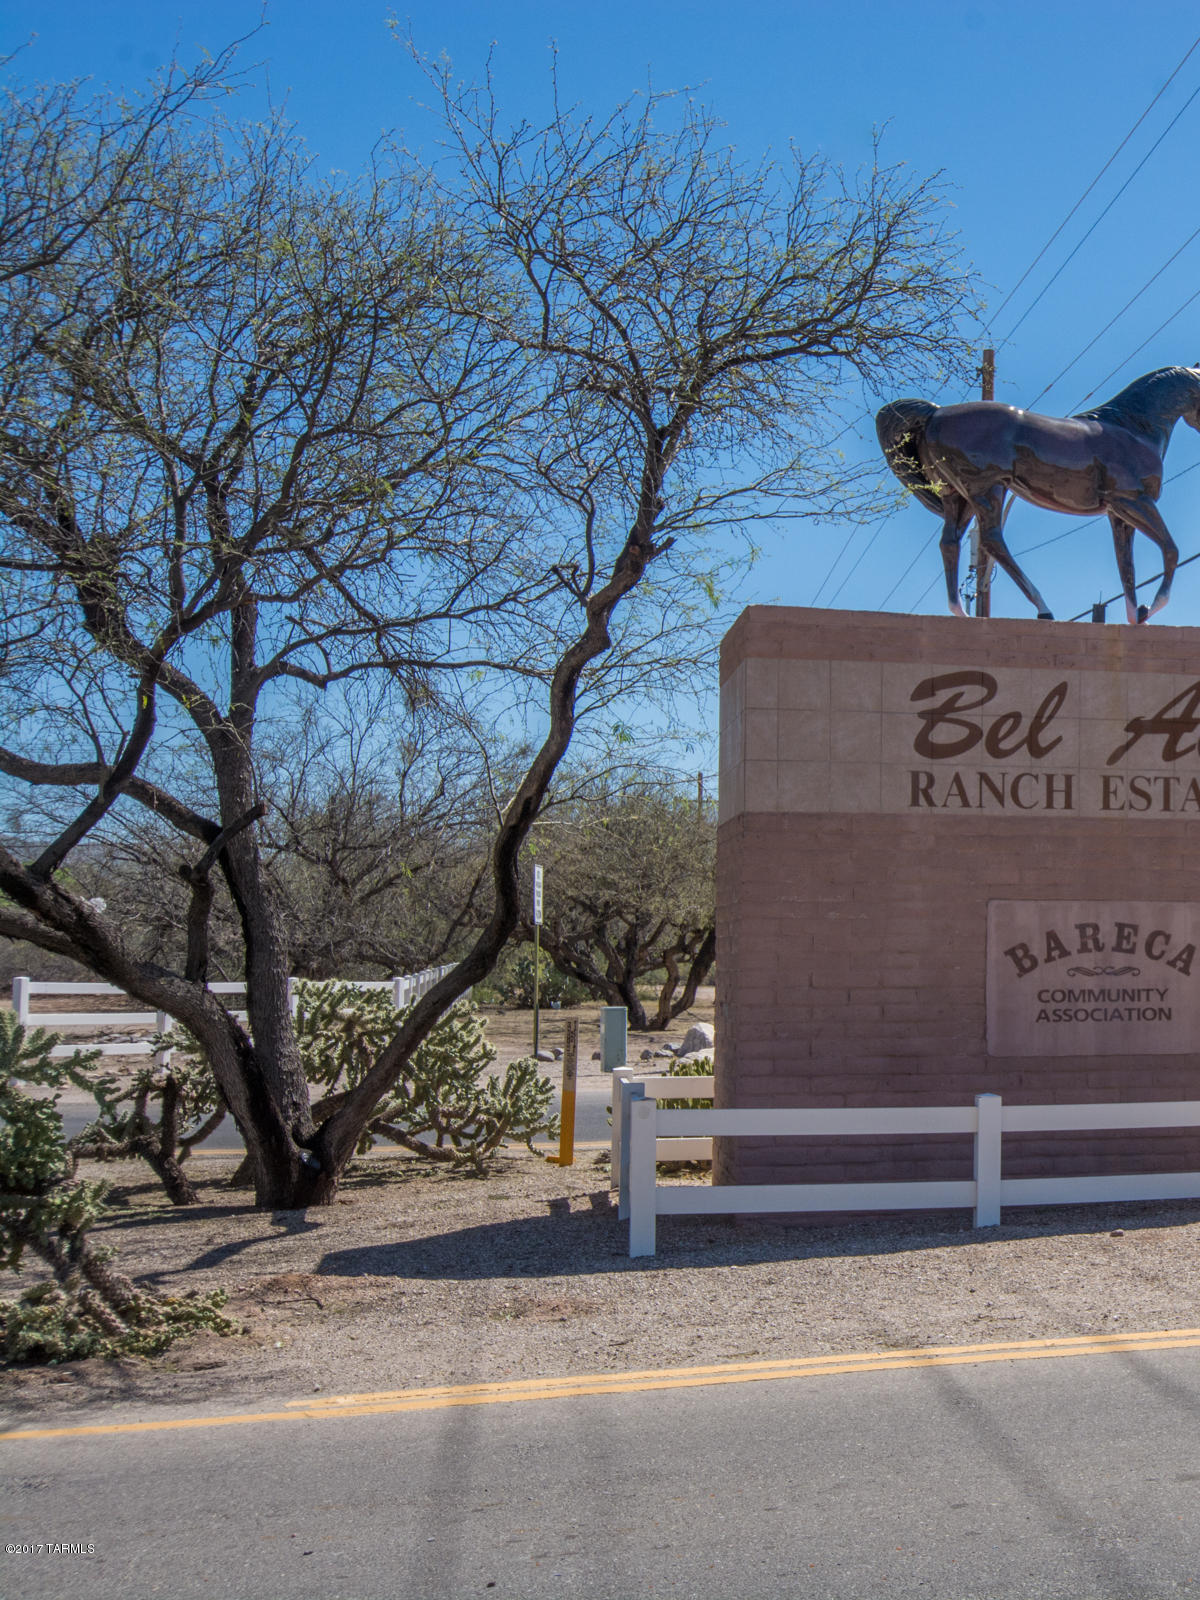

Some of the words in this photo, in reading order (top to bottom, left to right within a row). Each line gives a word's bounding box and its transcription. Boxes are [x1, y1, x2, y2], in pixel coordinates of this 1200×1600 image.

[910, 670, 1068, 760] Bel
[907, 769, 1076, 811] RANCH
[1004, 921, 1197, 978] BARECA
[1035, 1007, 1172, 1023] ASSOCIATION
[1037, 988, 1169, 1004] COMMUNITY
